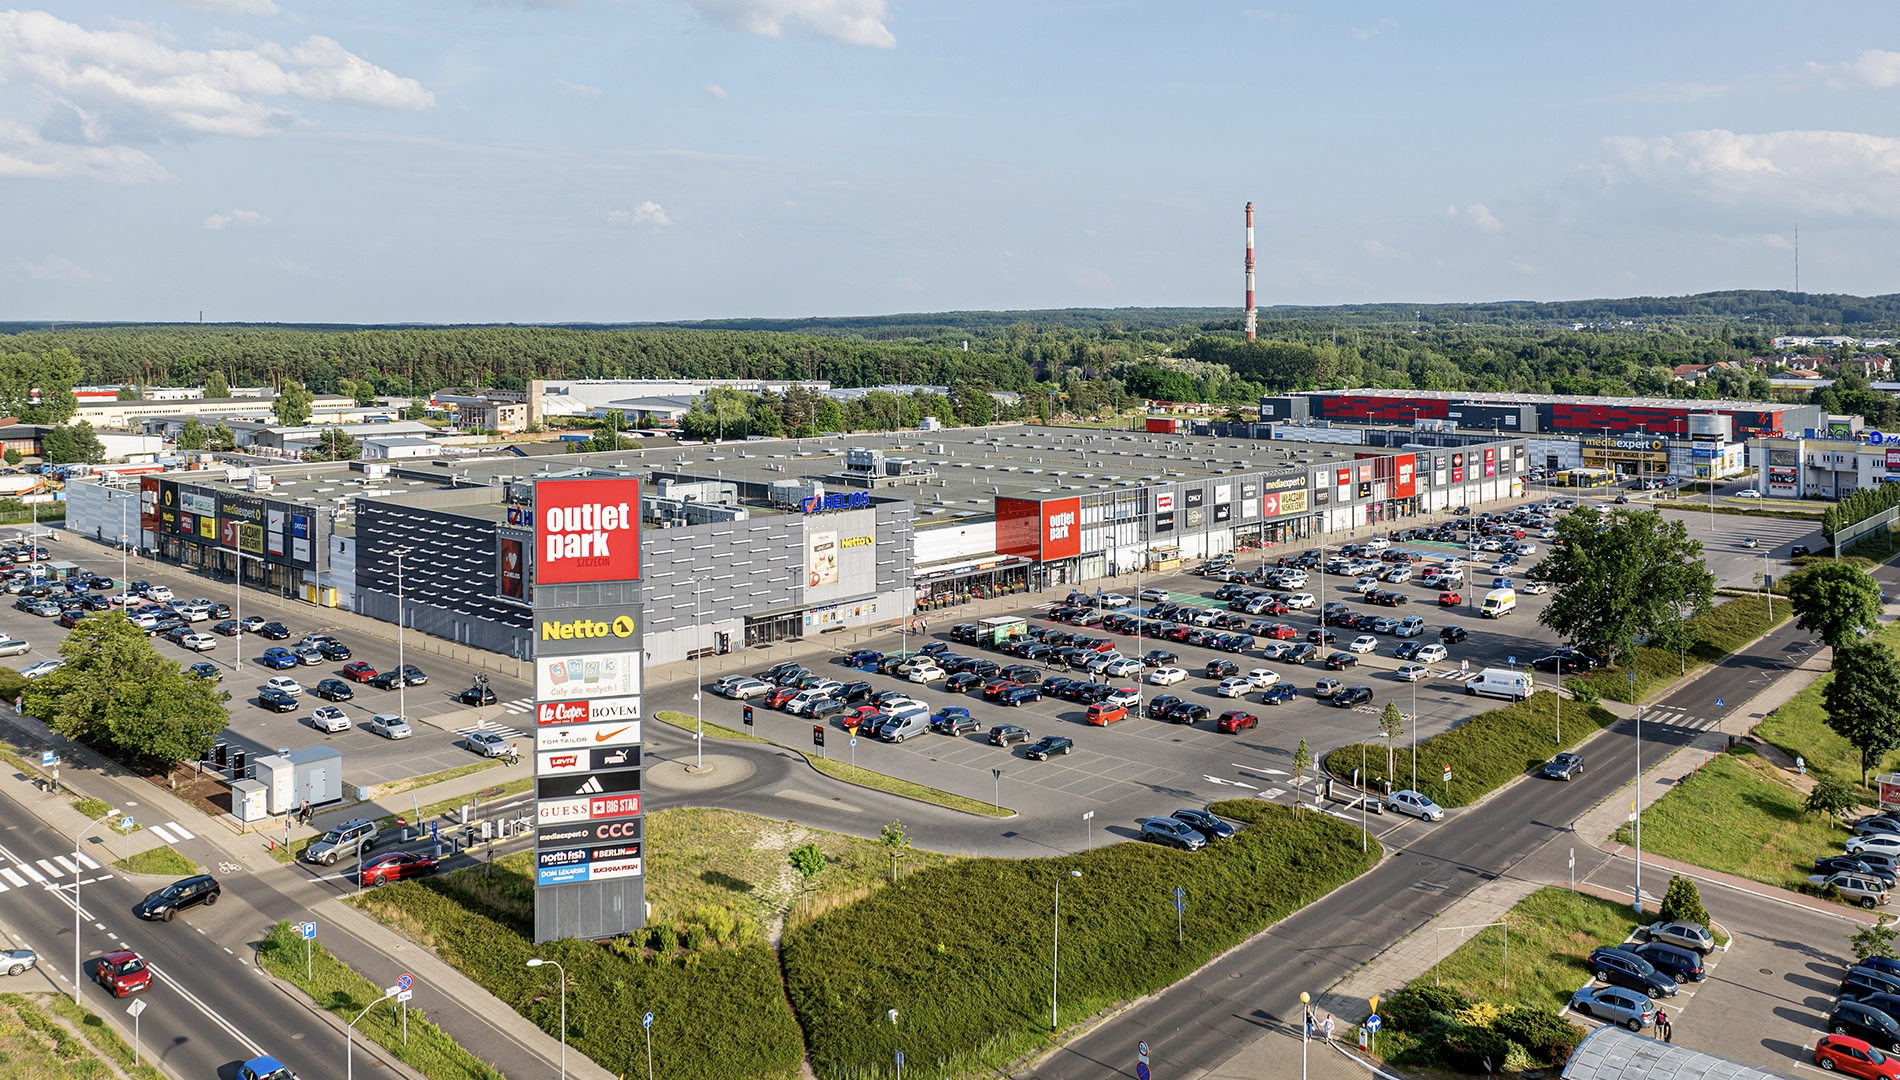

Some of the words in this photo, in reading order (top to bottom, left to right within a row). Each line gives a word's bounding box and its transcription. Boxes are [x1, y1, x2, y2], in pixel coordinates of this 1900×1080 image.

[1585, 438, 1650, 450] mediaexpert
[1266, 477, 1300, 490] mediaexpert
[824, 491, 869, 510] HELIOS
[1188, 494, 1201, 502] ONLY
[223, 504, 256, 519] mediaexpert
[546, 503, 630, 532] outlet
[1049, 511, 1075, 528] outlet
[1049, 525, 1069, 542] park
[546, 530, 610, 562] park
[841, 537, 865, 549] Netto
[576, 558, 610, 567] SZCZECIN
[541, 619, 609, 641] Netto
[550, 688, 568, 697] Cały
[585, 685, 612, 694] małych
[555, 703, 587, 722] Cooper
[592, 705, 637, 718] BOVEM
[540, 804, 588, 817] GUESS
[606, 800, 618, 813] BIG
[619, 798, 638, 812] STAR
[540, 831, 582, 841] mediaexpert
[596, 822, 634, 839] CCC
[541, 851, 567, 863] north
[567, 850, 586, 860] fish
[599, 848, 626, 858] BERLIN
[541, 870, 557, 878] DOM
[558, 867, 586, 876] LEKARSKI
[305, 924, 314, 935] P
